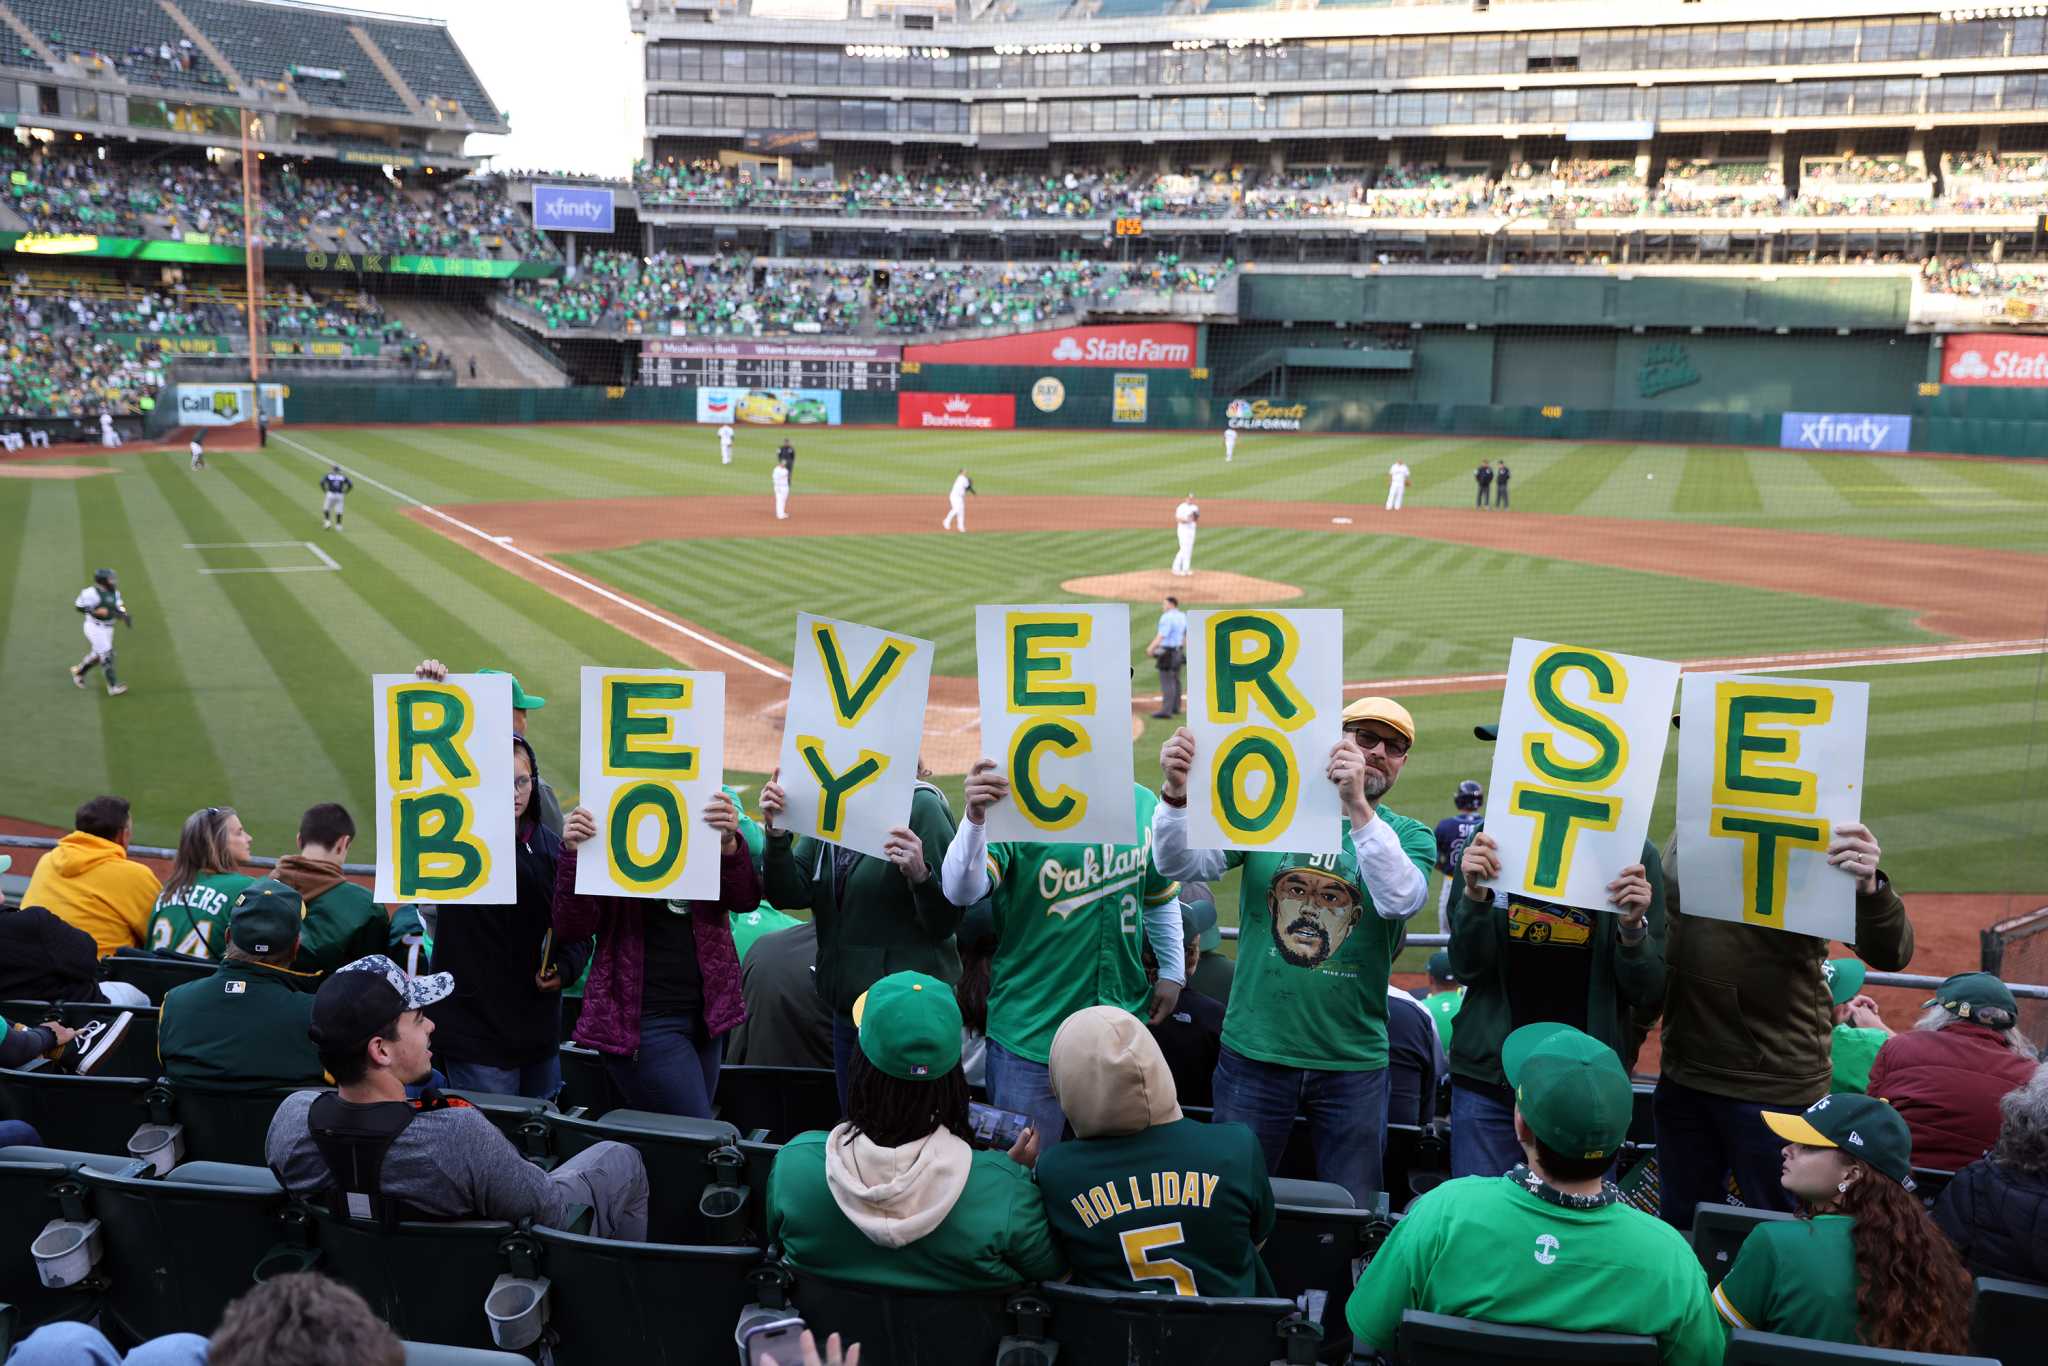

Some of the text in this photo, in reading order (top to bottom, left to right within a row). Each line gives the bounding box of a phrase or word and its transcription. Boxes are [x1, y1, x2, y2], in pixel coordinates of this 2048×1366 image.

[545, 197, 603, 222] xfinity
[305, 251, 494, 278] OAKLAND
[182, 396, 210, 412] Call
[922, 412, 992, 428] Budweiser
[1229, 418, 1300, 430] CALIFORNIA
[1800, 416, 1889, 449] xfinity
[1039, 826, 1152, 899] Oakland
[155, 884, 229, 915] FNGERS
[1071, 1171, 1219, 1228] HOLLIDAY
[1119, 1222, 1199, 1297] 5
